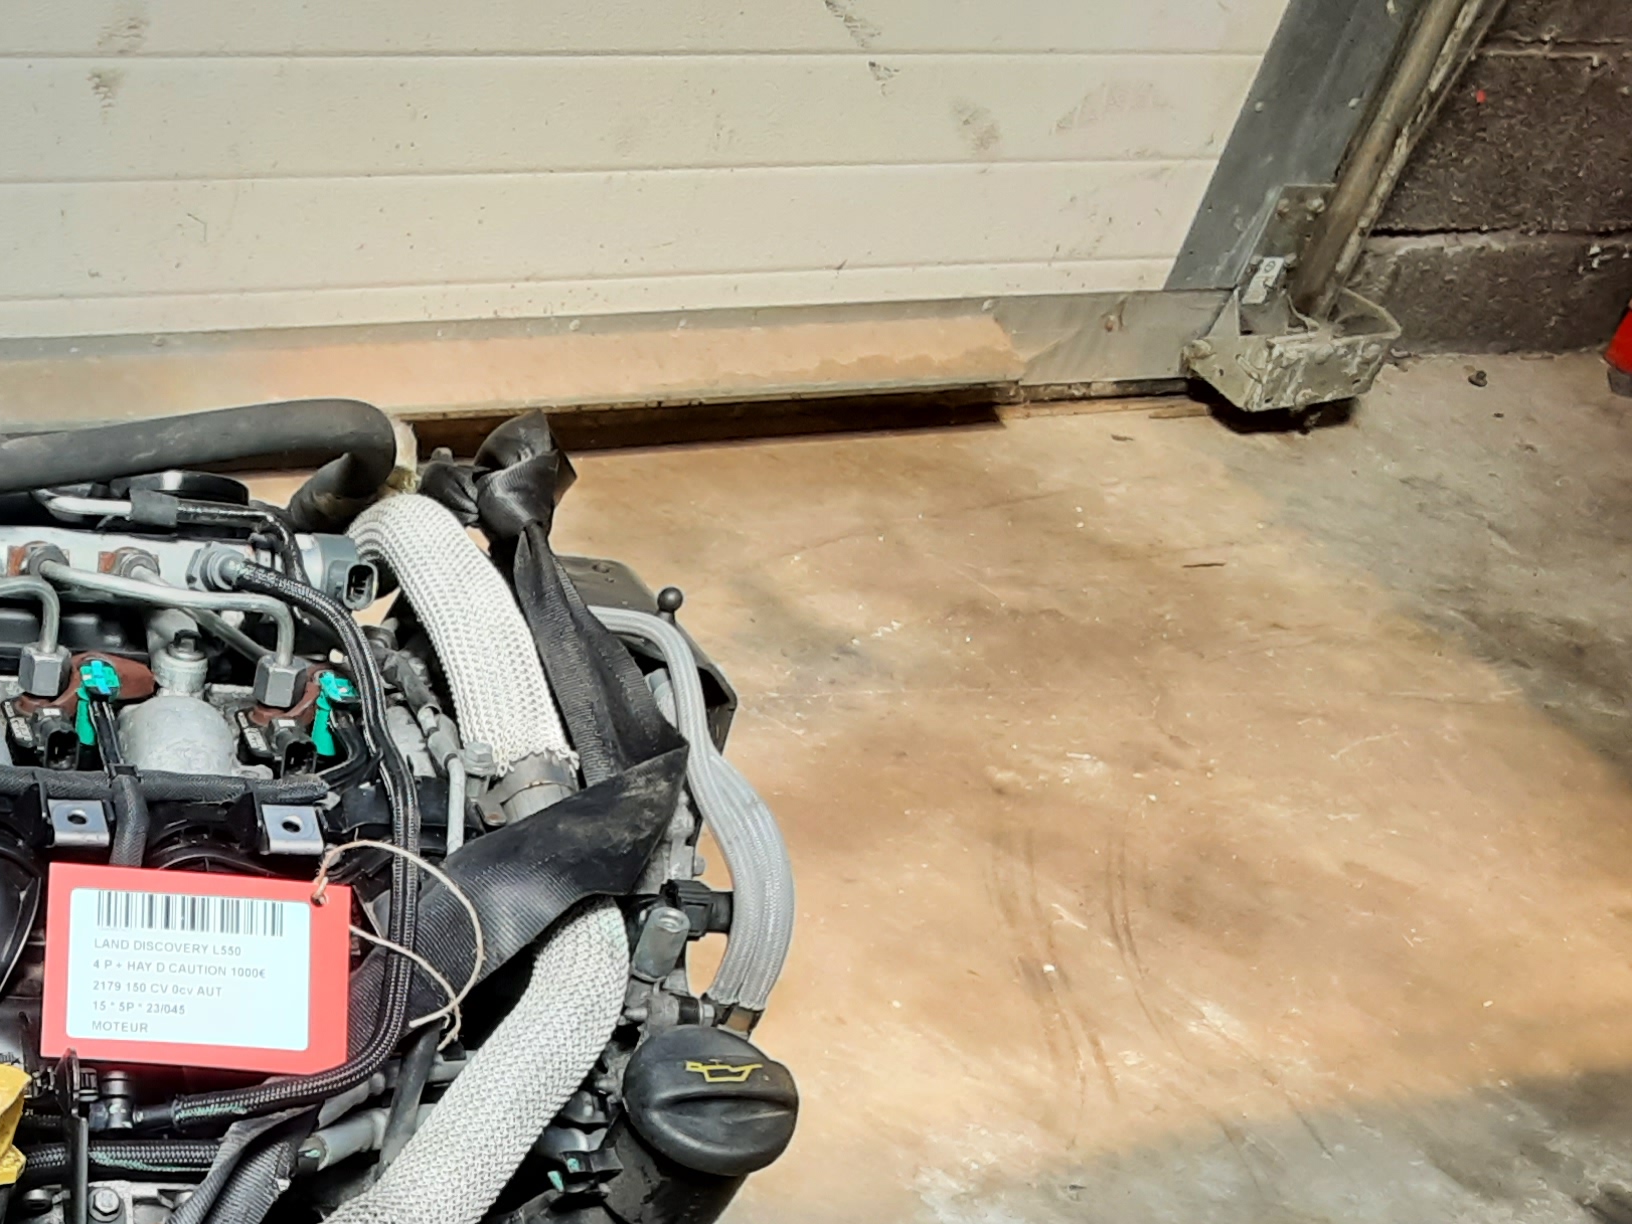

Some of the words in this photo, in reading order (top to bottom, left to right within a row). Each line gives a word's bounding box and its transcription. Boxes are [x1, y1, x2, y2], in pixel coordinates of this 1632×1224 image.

[93, 937, 130, 951] LAND
[133, 939, 209, 955] DISCOVERY
[212, 943, 242, 957] L550
[92, 959, 101, 970] 4
[104, 959, 113, 970] P
[115, 961, 123, 969] +
[127, 960, 153, 973] HAY
[156, 962, 166, 973] D
[168, 962, 227, 977] CAUTION
[230, 966, 267, 979] 1000€
[92, 980, 122, 992] 2179
[126, 982, 147, 994] 150
[150, 982, 169, 995] CV
[196, 985, 223, 998] AUT
[92, 1000, 107, 1012] 15
[118, 1001, 135, 1013] 5P
[145, 1002, 186, 1016] 23/045
[91, 1020, 149, 1034] MOTEUR
